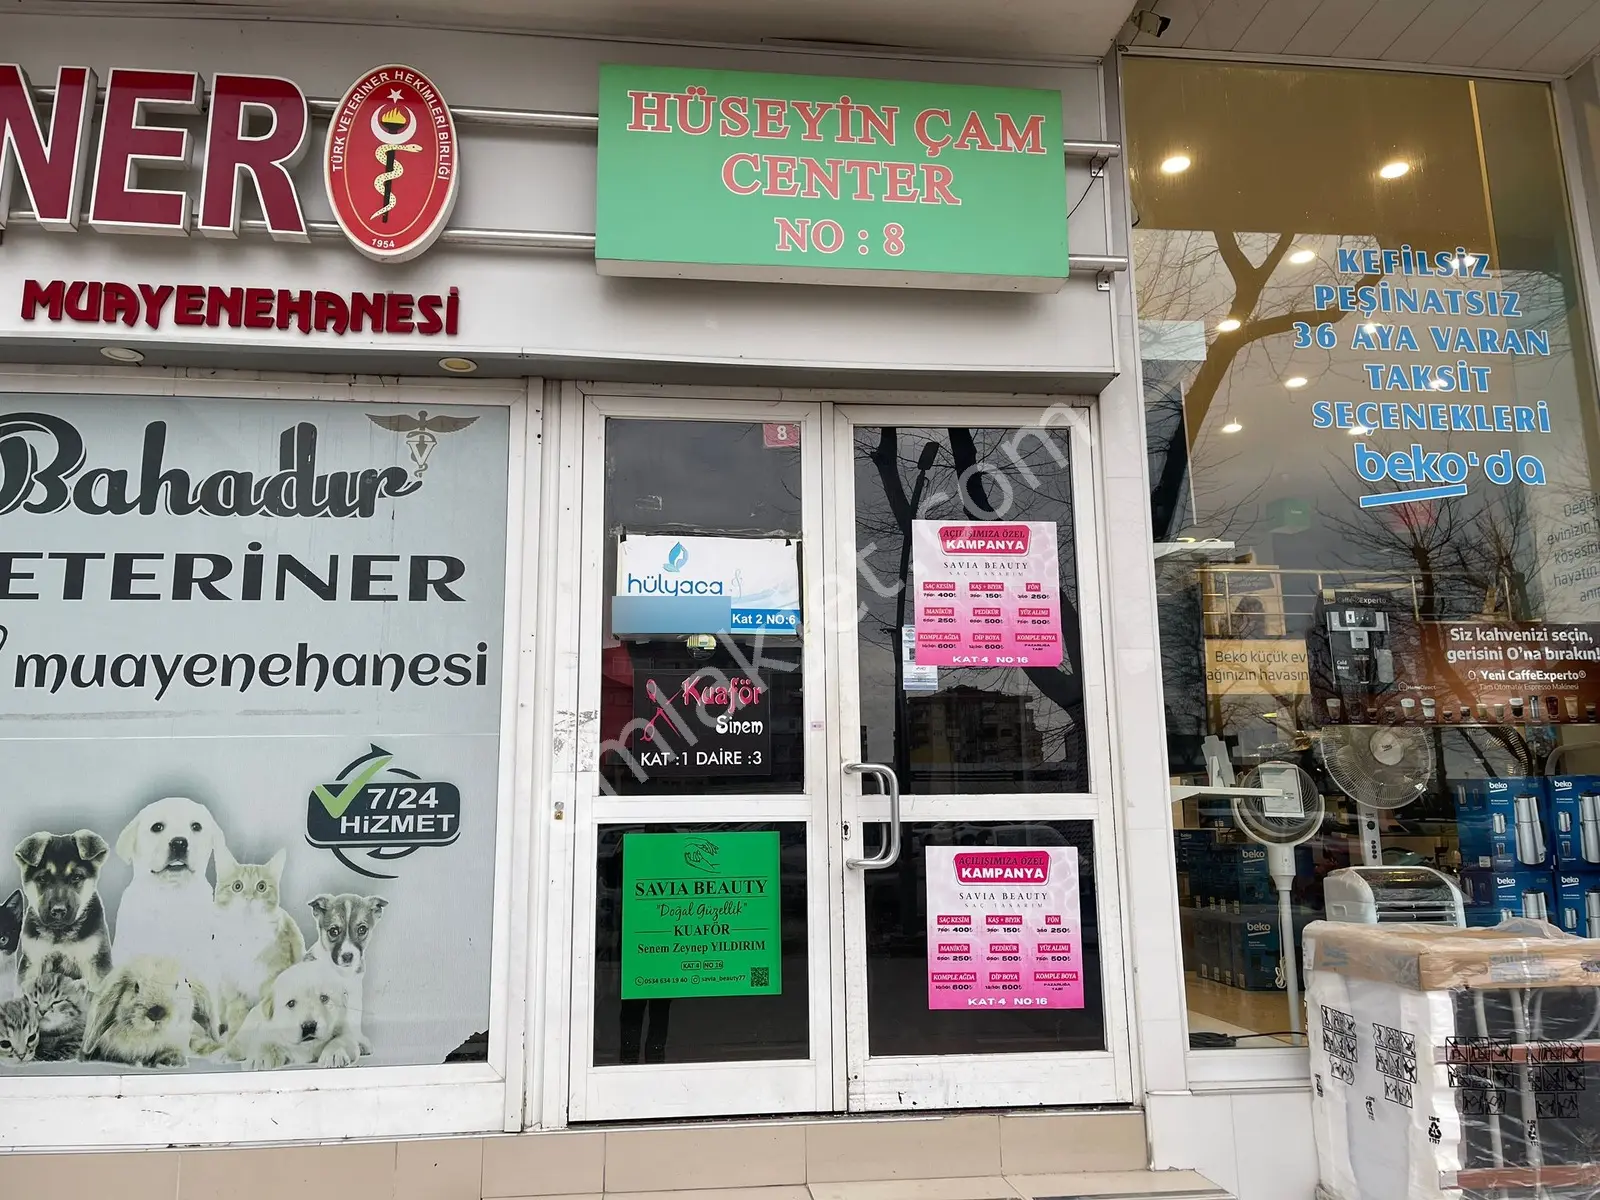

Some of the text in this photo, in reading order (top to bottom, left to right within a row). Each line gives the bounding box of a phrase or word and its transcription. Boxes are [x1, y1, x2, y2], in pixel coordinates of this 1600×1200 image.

[331, 70, 451, 180] TÜRK VETERİNER HEKİMLERİ BİRLİĞİ
[626, 85, 1047, 156] HÜSEYİN ÇAM
[721, 152, 962, 206] CENTER
[371, 238, 395, 249] 1954
[773, 217, 845, 254] NO
[883, 222, 906, 257] 8
[1338, 244, 1493, 280] KEFİLSİZ
[21, 279, 459, 335] MUAYENEHANESİ
[1312, 282, 1523, 319] PEŞİNATSIZ
[1292, 322, 1550, 357] 36 AYA VARAN
[1363, 359, 1492, 393] TAKSİT
[1311, 400, 1552, 435] SEÇENEKLERİ
[777, 425, 788, 441] 8
[1002, 529, 1025, 538] ÖZEL
[946, 539, 1024, 550] KAMPANYA
[732, 613, 796, 625] Kat 2 NO:6
[1450, 627, 1593, 644] Siz kahvenizi seçin,
[1215, 650, 1307, 665] Beko küçük ev
[1447, 646, 1503, 663] gerisini
[1545, 646, 1600, 661] bırakın!
[15, 642, 488, 701] muayenehanesi
[1480, 670, 1506, 680] Yeni
[682, 676, 762, 713] Kuaför
[715, 714, 764, 736] Sinem
[640, 752, 671, 767] KAT
[696, 747, 742, 766] DAİRE
[1489, 781, 1508, 793] beko
[1554, 780, 1572, 791] beko
[367, 787, 439, 809] 7/24
[1020, 855, 1045, 865] ÖZEL
[1242, 849, 1265, 862] beko
[961, 867, 1044, 879] KAMPANYA
[635, 879, 768, 897] SAVIA BEAUTY
[1496, 877, 1516, 888] beko
[1561, 876, 1579, 887] beko
[959, 892, 1048, 900] SAVIA BEAUTY
[673, 922, 730, 936] KUAFÖR
[1247, 922, 1271, 936] beko
[638, 940, 765, 955] Senem Zeynep YILDIRIM
